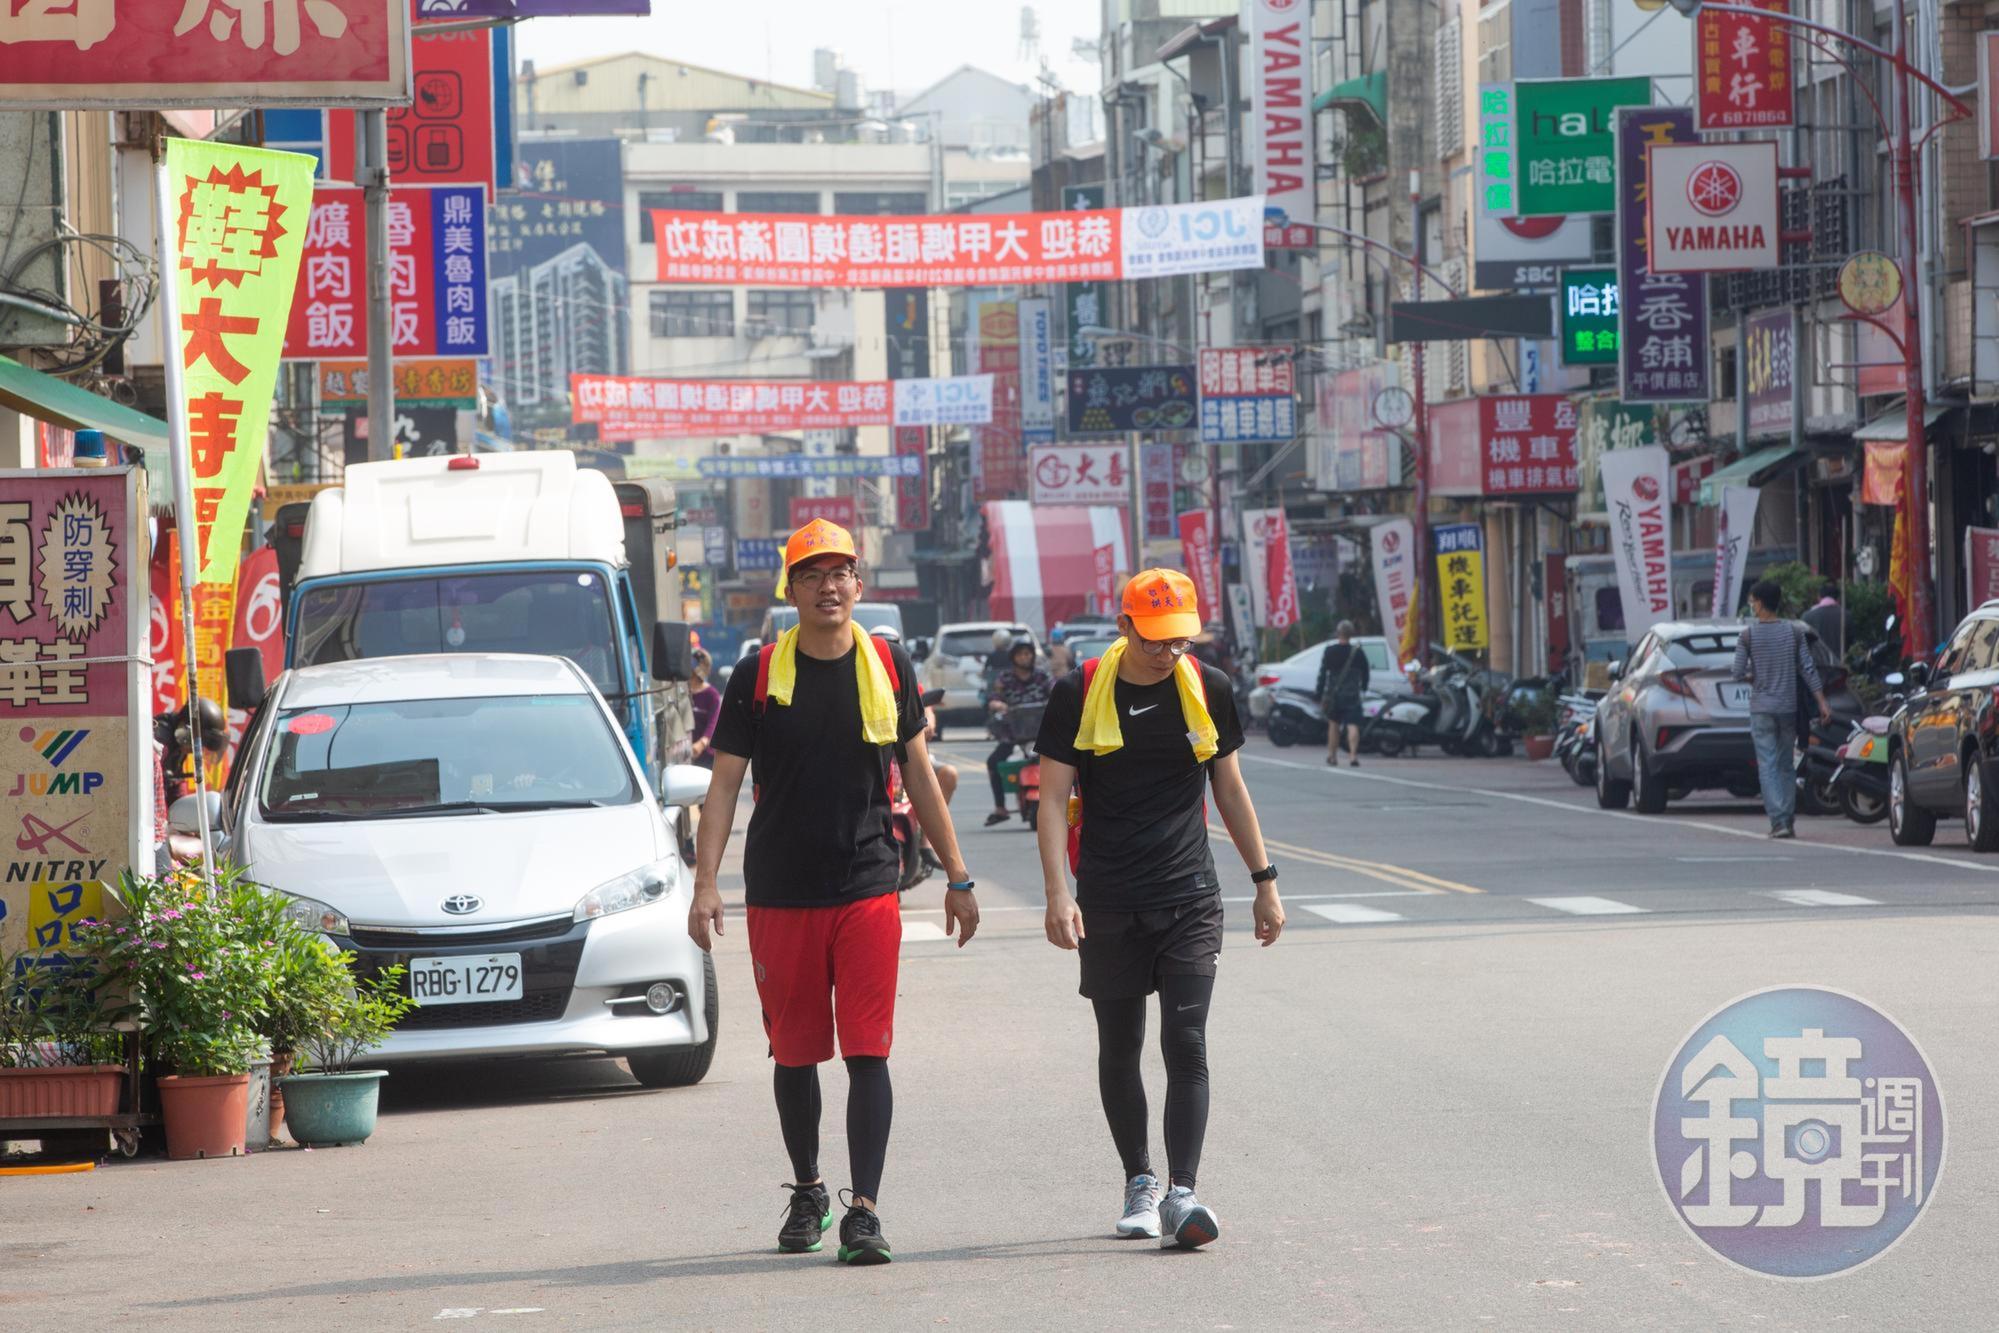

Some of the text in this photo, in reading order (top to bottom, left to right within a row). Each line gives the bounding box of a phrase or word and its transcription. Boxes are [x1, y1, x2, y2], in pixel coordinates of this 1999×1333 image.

[1264, 21, 1304, 196] YAMAHA
[1532, 106, 1615, 137] hal
[1529, 156, 1616, 187] 哈拉電
[1666, 224, 1766, 251] YAMAHA
[443, 195, 476, 344] 鼎美魯肉飯
[1575, 330, 1620, 352] 整合
[63, 513, 93, 620] 防穿刺
[1638, 504, 1668, 614] YAMAHA
[8, 771, 104, 797] JUMP
[6, 859, 107, 883] NITRY
[413, 965, 518, 999] RBG-1279
